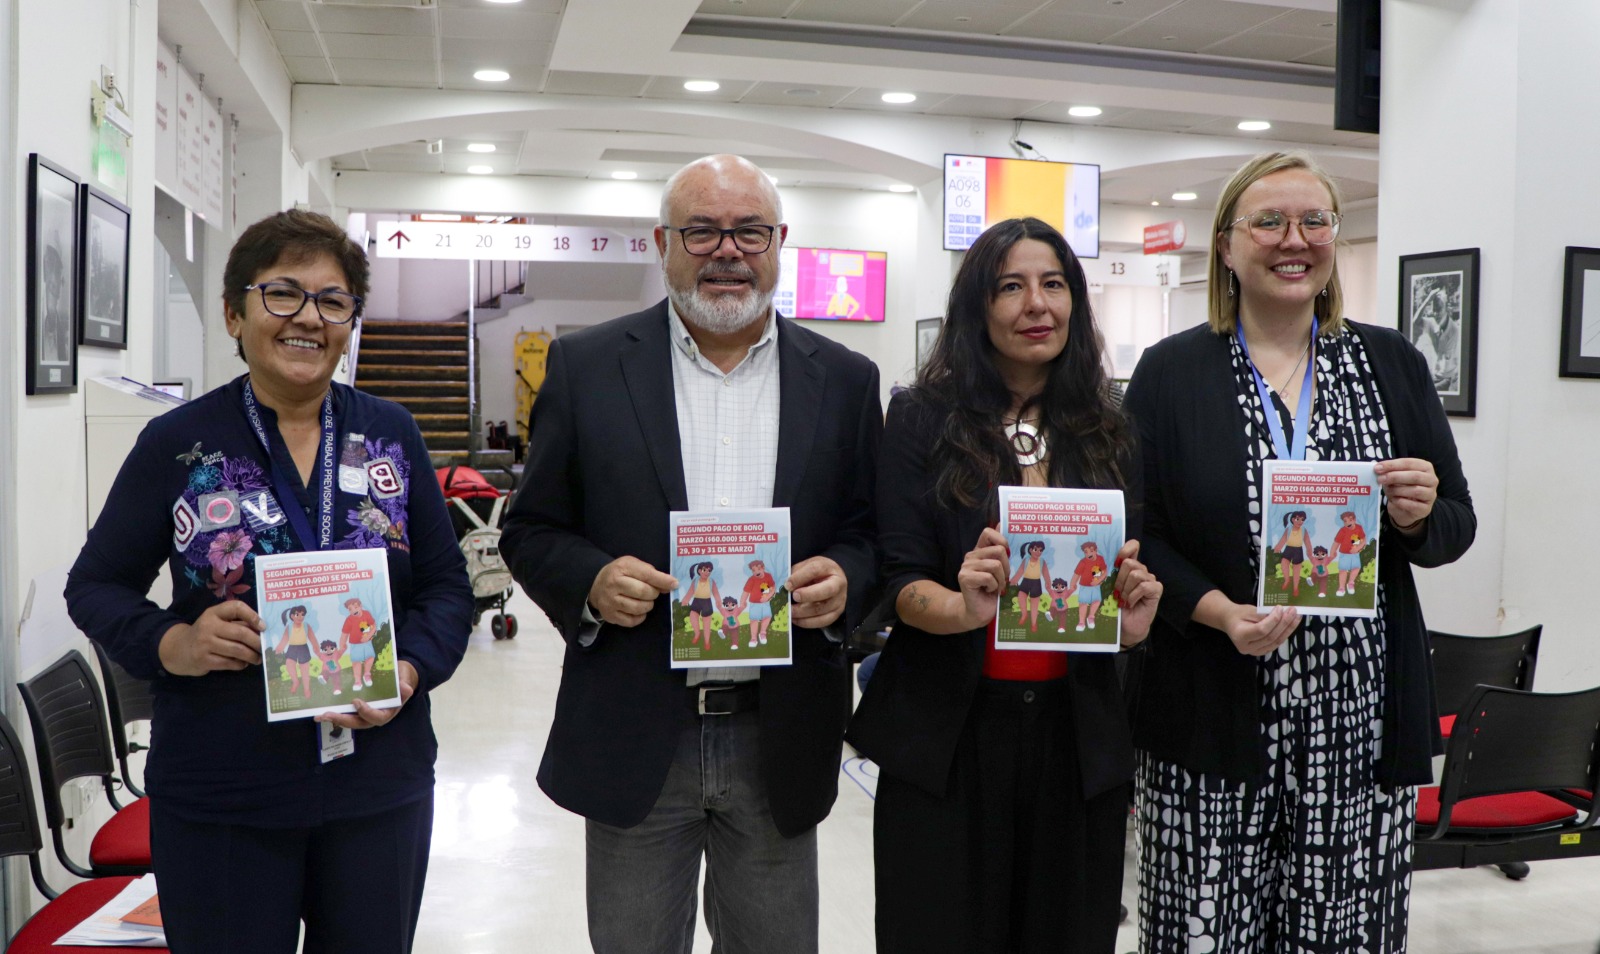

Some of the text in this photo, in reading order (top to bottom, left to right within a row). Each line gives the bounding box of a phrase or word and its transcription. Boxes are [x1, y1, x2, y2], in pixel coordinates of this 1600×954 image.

[949, 179, 980, 192] A098
[956, 195, 971, 208] 06
[435, 234, 647, 252] 21 20 19 18 17 16
[1111, 262, 1125, 275] 13
[325, 416, 333, 429] DEL
[324, 432, 334, 468] TRABAJO
[323, 469, 333, 514] PREVISIÓN
[1010, 502, 1044, 510] SEGUNDO
[1045, 503, 1064, 511] PAGO
[1010, 513, 1036, 521] MARZO
[321, 515, 331, 548] SOCIAL
[679, 525, 712, 533] SEGUNDO
[713, 524, 731, 532] PAGO
[1010, 524, 1022, 532] 29,
[679, 536, 704, 544] MARZO
[266, 568, 301, 578] SEGUNDO
[302, 566, 322, 574] PAGO
[334, 562, 356, 570] BONO
[266, 580, 294, 589] MARZO
[341, 572, 361, 580] PAGA
[320, 585, 347, 594] MARZO
